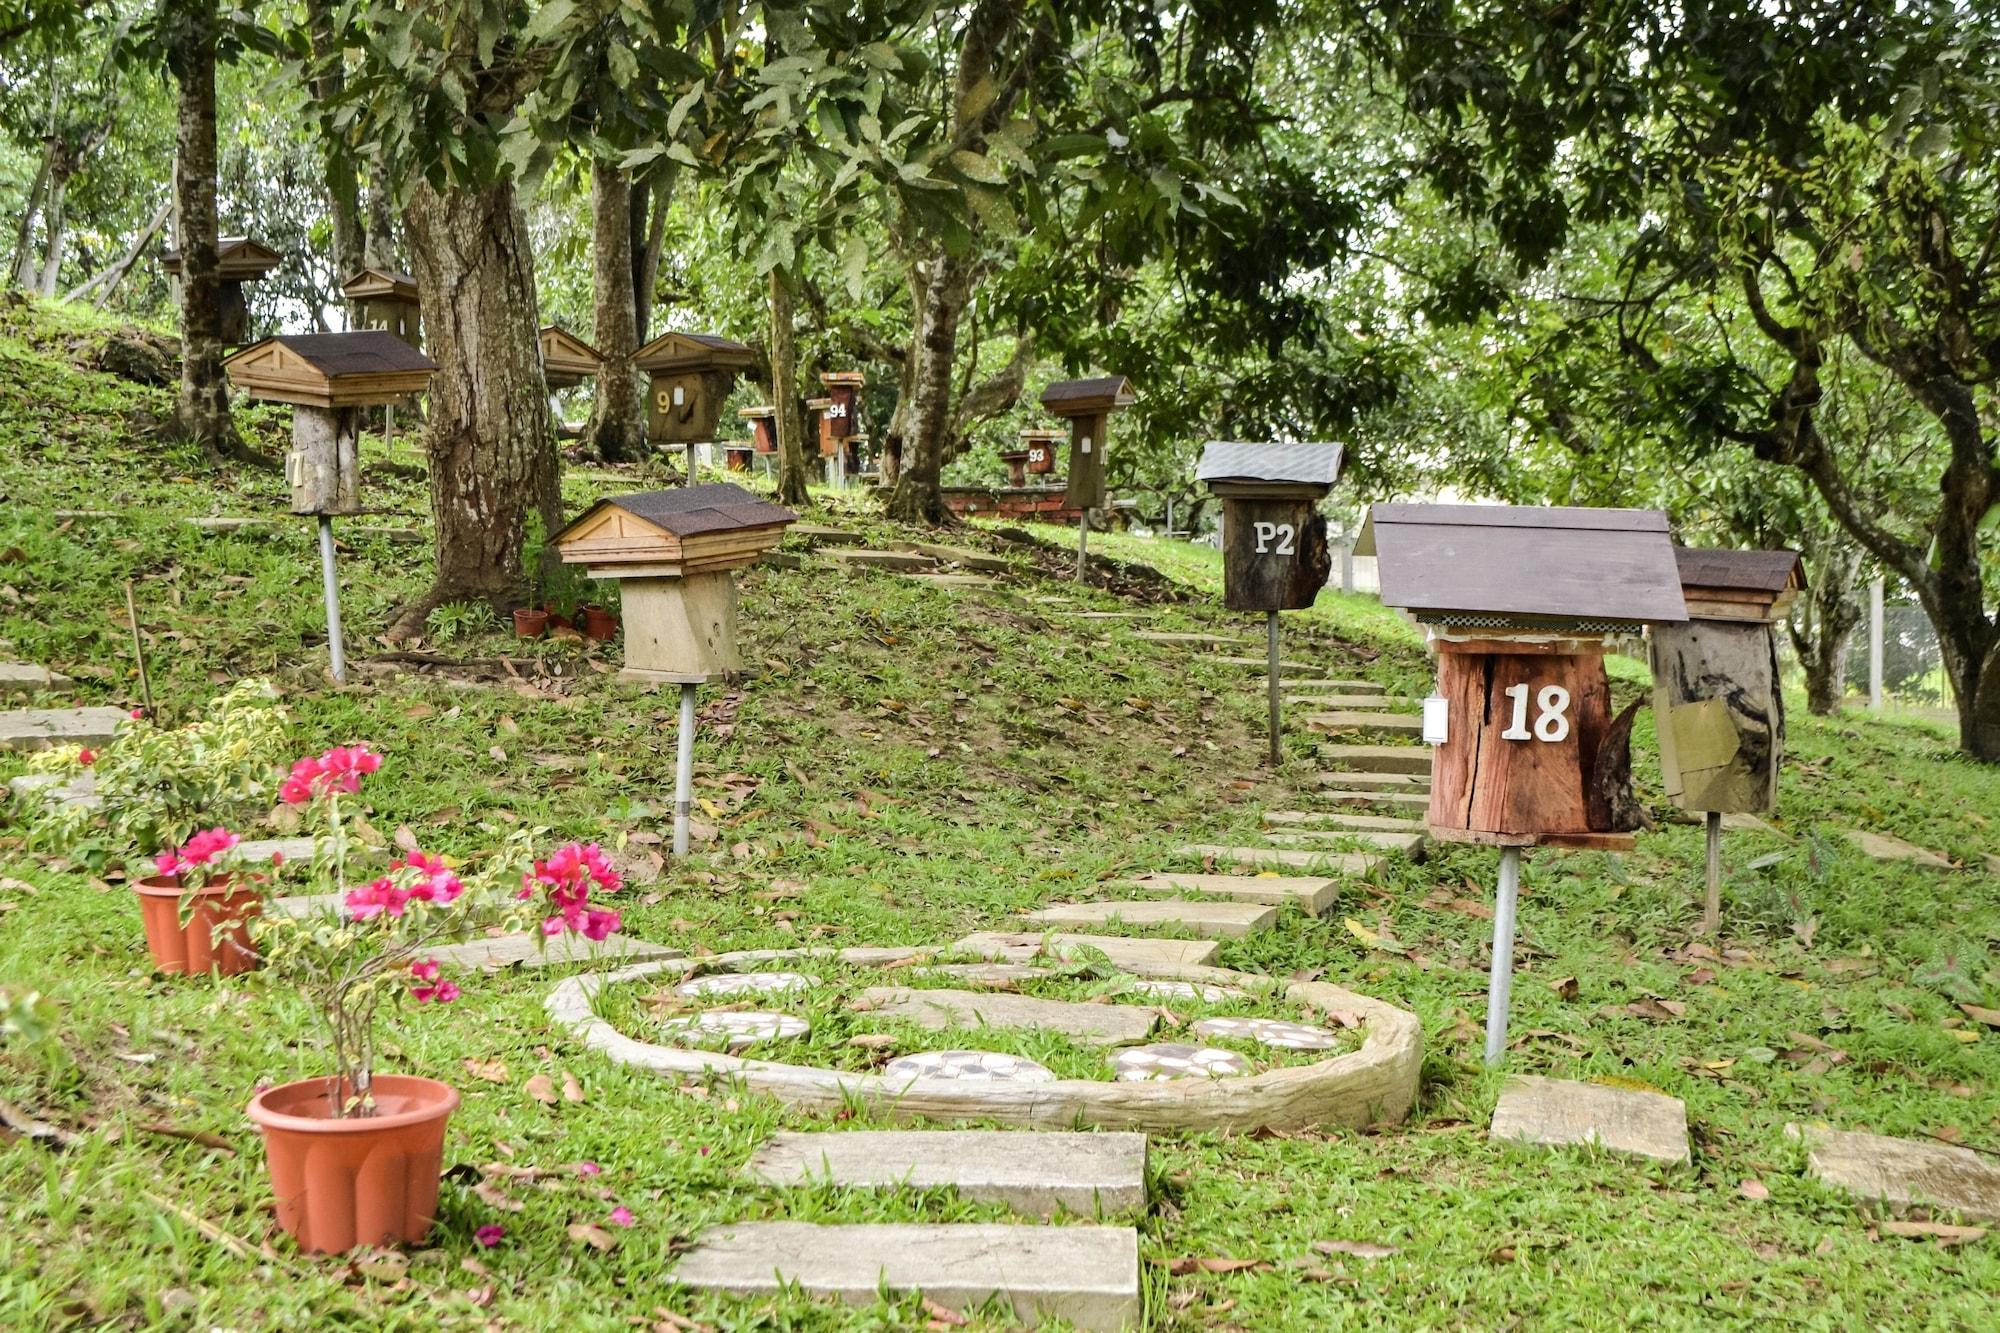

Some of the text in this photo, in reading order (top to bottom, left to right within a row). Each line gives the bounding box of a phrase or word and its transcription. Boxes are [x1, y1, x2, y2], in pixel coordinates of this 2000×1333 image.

[657, 391, 670, 414] 9
[830, 403, 846, 418] 94
[1029, 449, 1045, 462] 93
[1253, 521, 1295, 555] P2
[1501, 682, 1570, 742] 18
